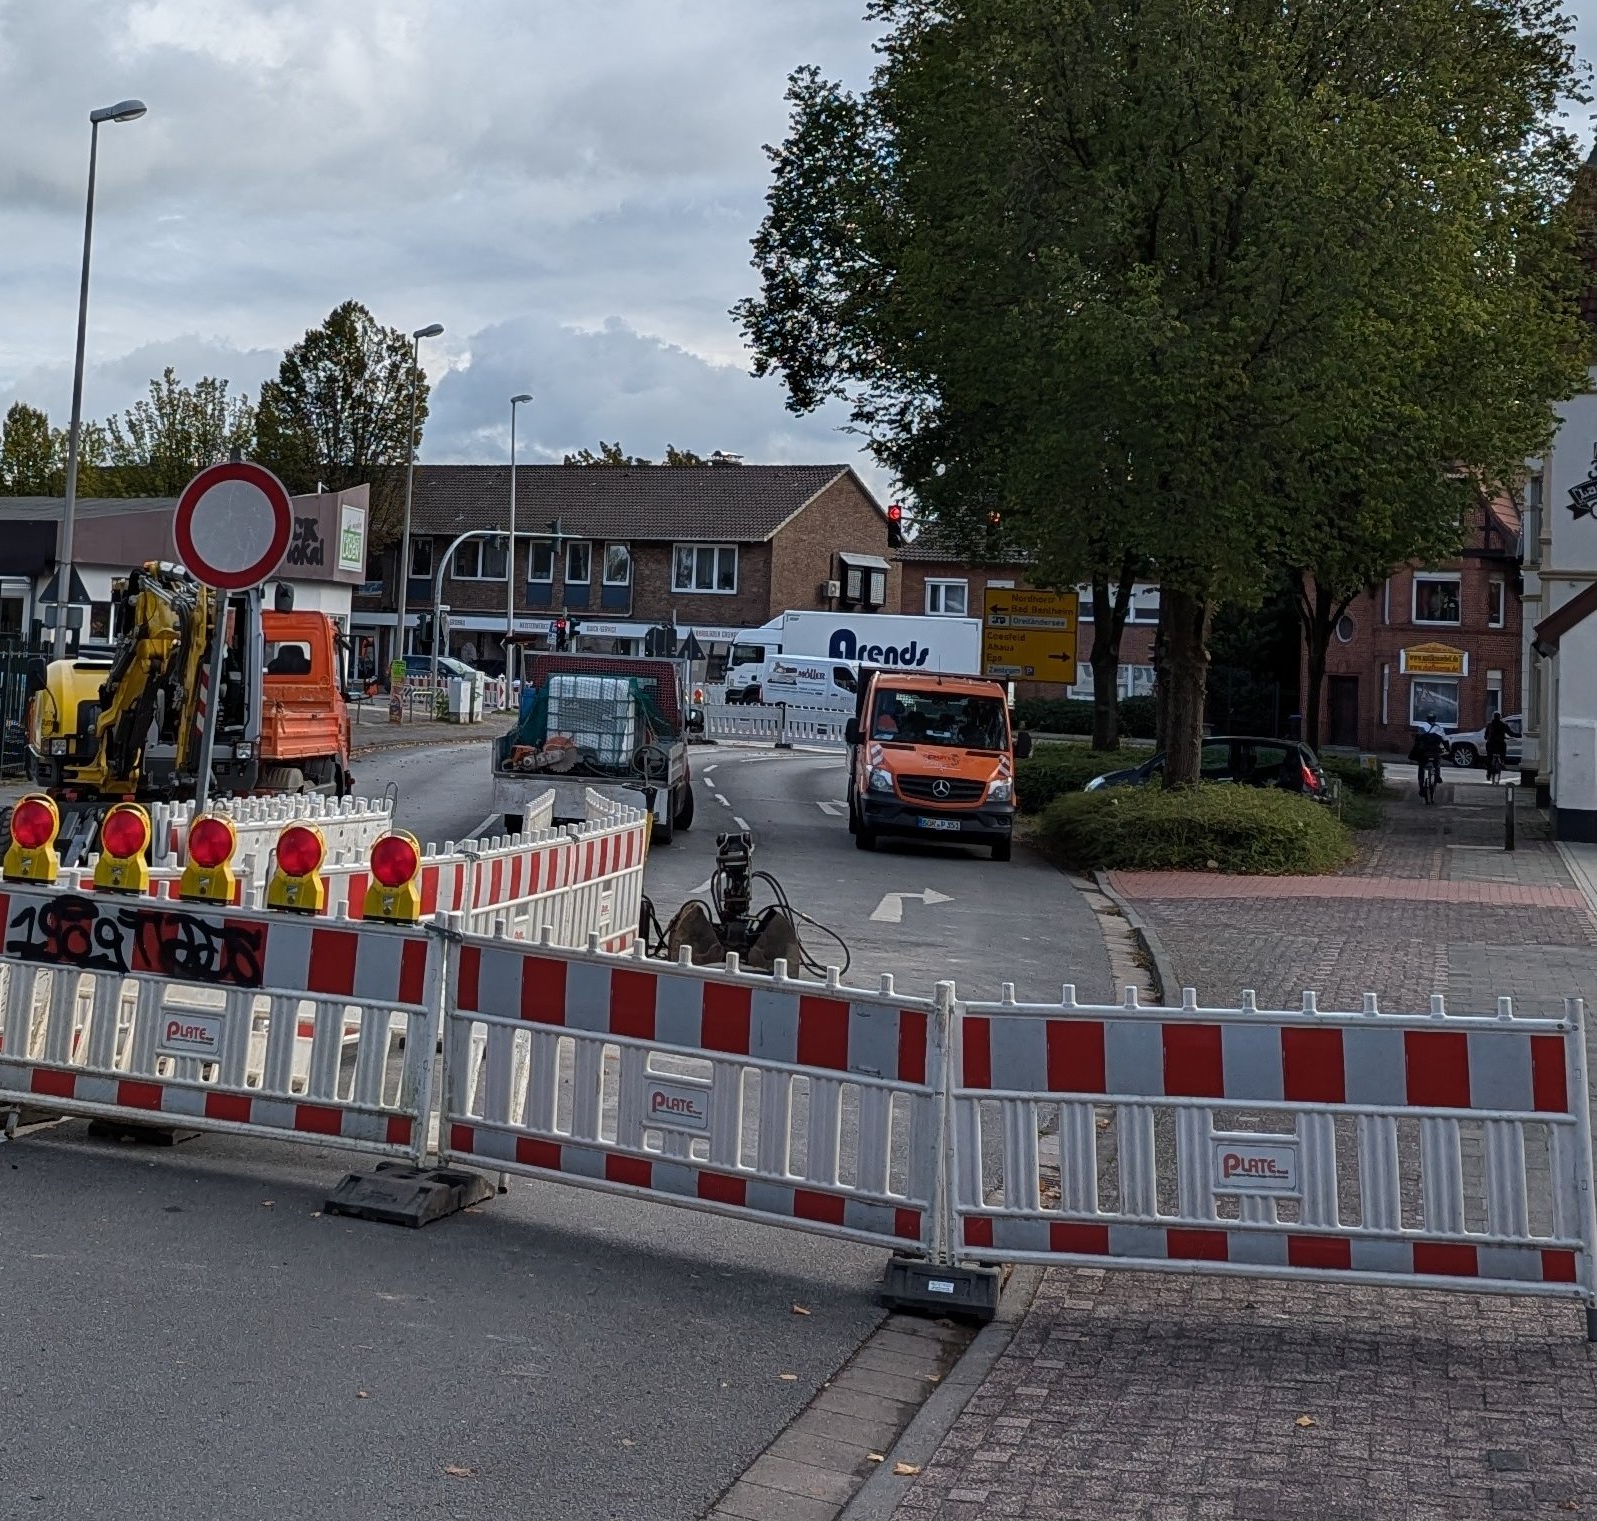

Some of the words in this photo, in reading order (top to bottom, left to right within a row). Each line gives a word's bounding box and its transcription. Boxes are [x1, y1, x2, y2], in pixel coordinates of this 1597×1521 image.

[1011, 605, 1028, 613] Bad
[1031, 606, 1074, 615] Bentheim
[829, 628, 930, 667] Arends
[166, 1021, 207, 1041] PLATE
[652, 1091, 694, 1113] PLATE
[1223, 1153, 1276, 1178] PLATE
